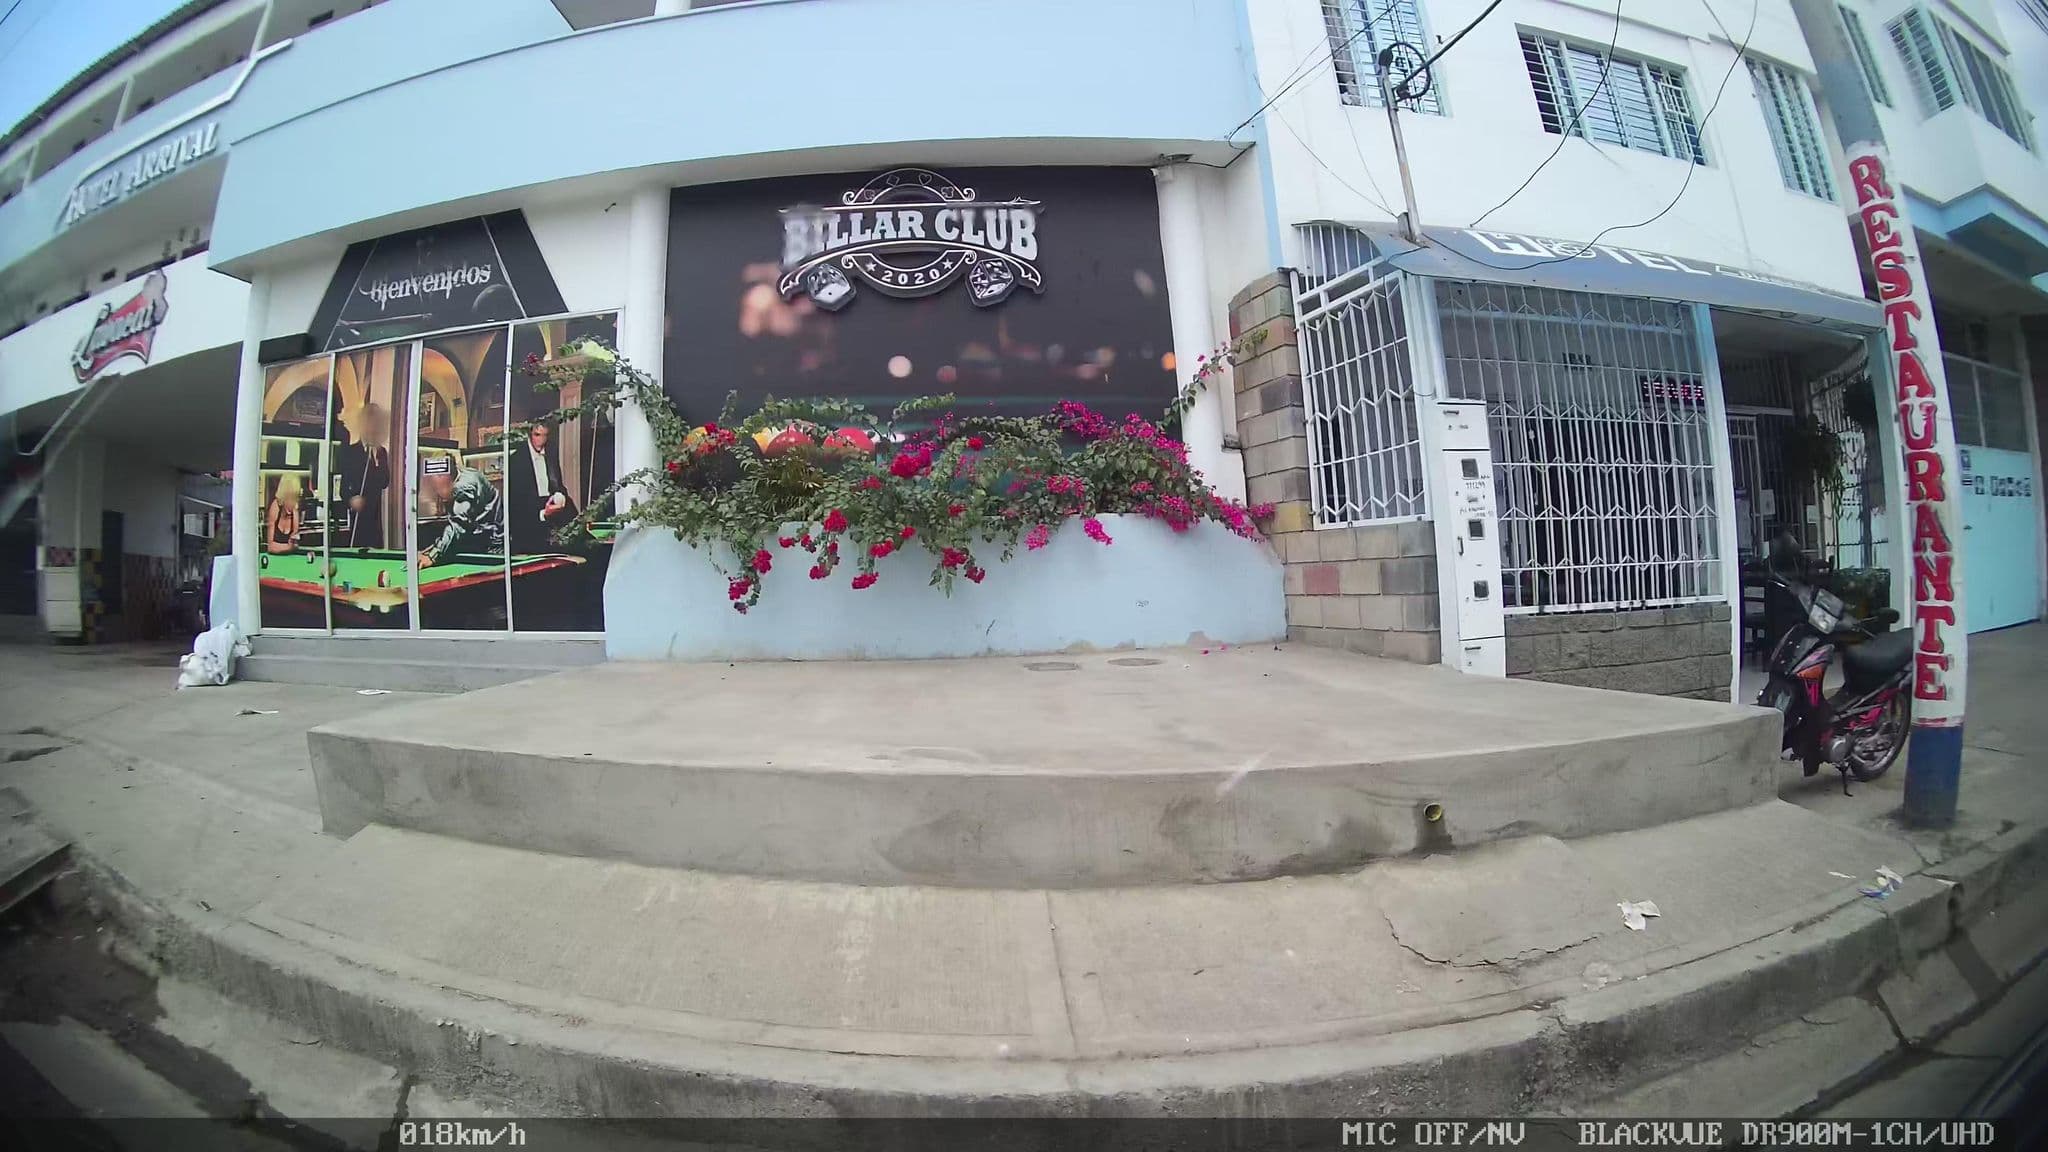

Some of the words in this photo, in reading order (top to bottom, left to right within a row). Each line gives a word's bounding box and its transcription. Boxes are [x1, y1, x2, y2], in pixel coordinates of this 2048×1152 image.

[127, 121, 219, 193] ARRIVAL
[782, 210, 926, 268] BILLAR
[934, 208, 1038, 262] CLUB
[1463, 229, 1713, 276] HOTEL
[881, 267, 940, 285] 2020
[1849, 154, 1957, 701] RESTAURANTE
